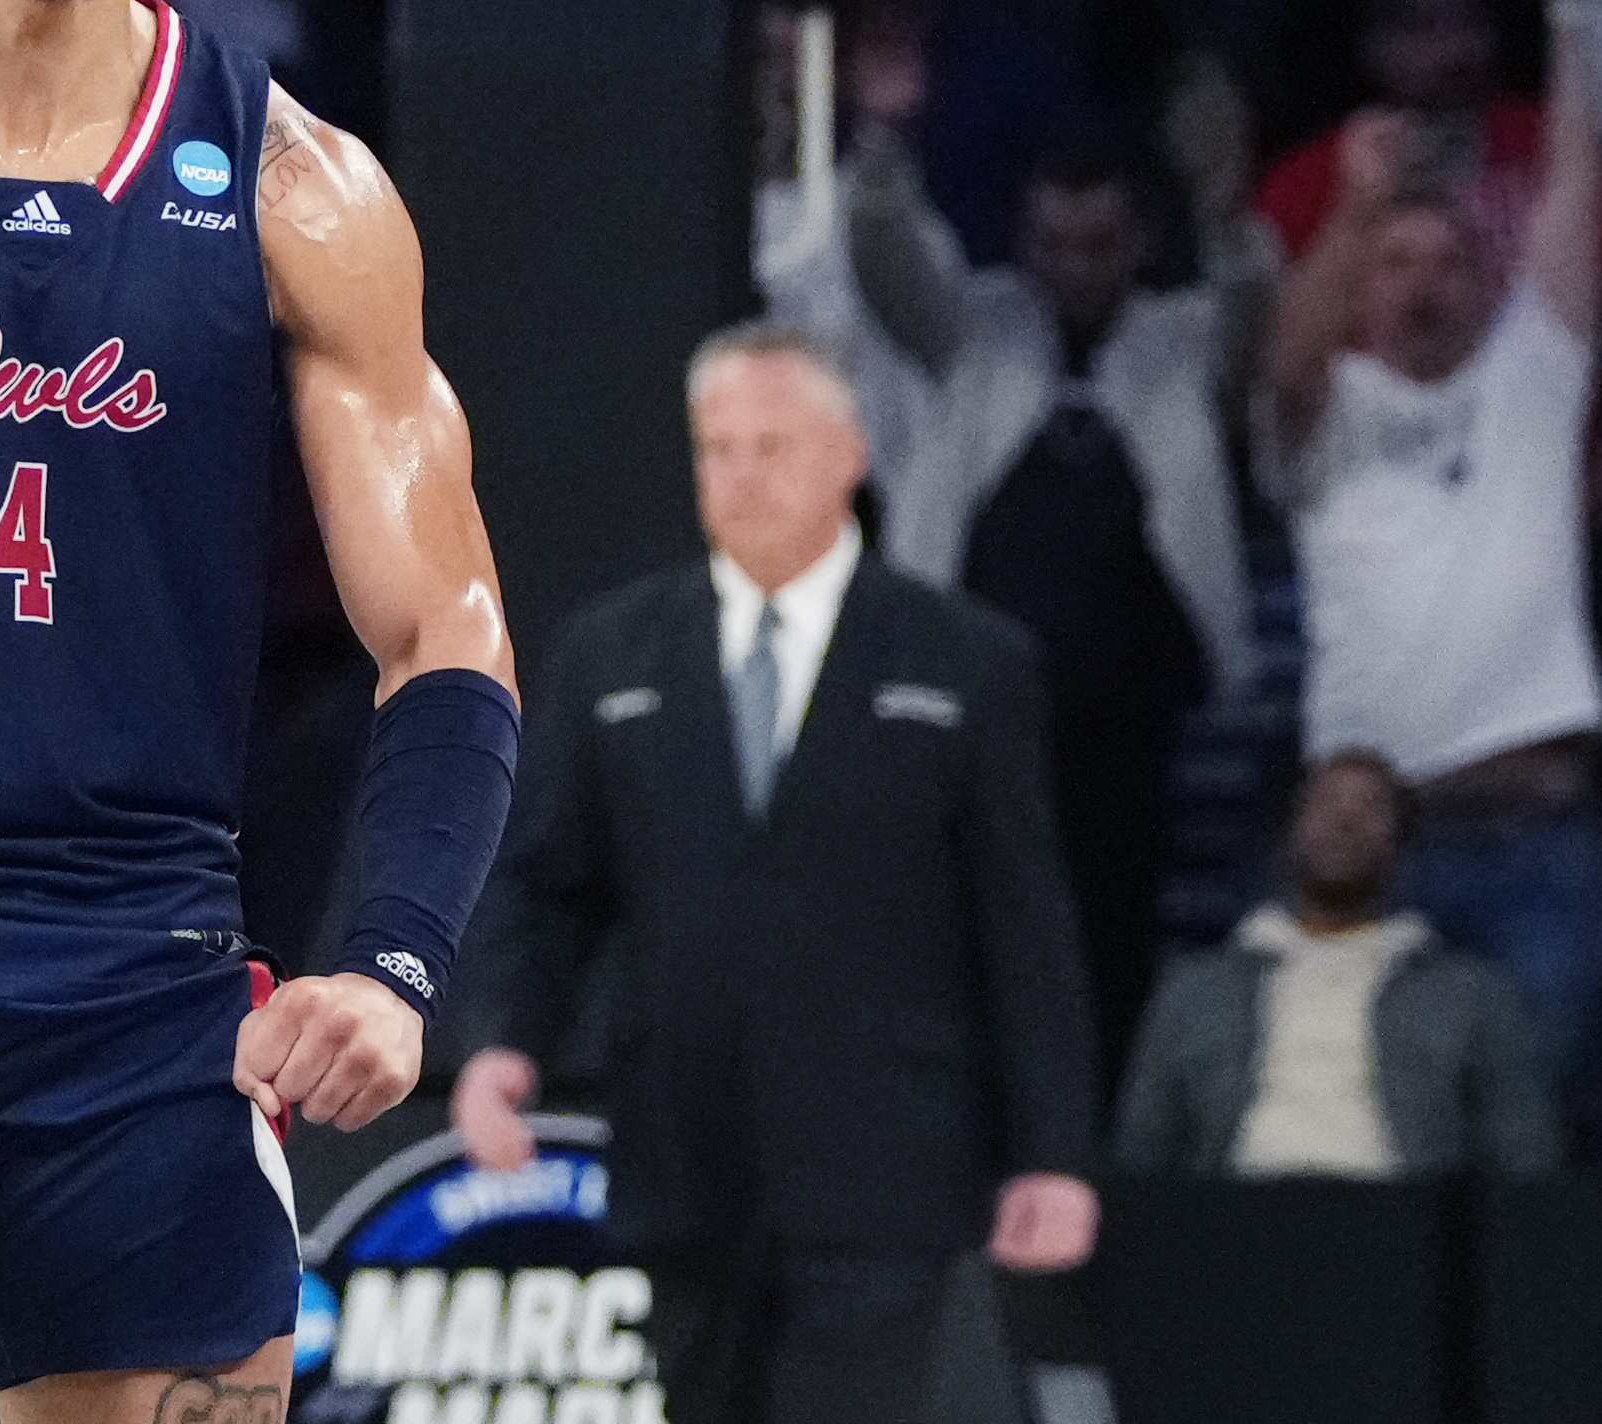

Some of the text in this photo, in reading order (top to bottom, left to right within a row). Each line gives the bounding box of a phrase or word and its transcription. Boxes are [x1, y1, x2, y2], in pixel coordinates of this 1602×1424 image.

[180, 162, 230, 184] NCAA
[2, 218, 72, 236] adidas
[376, 952, 435, 999] adidas
